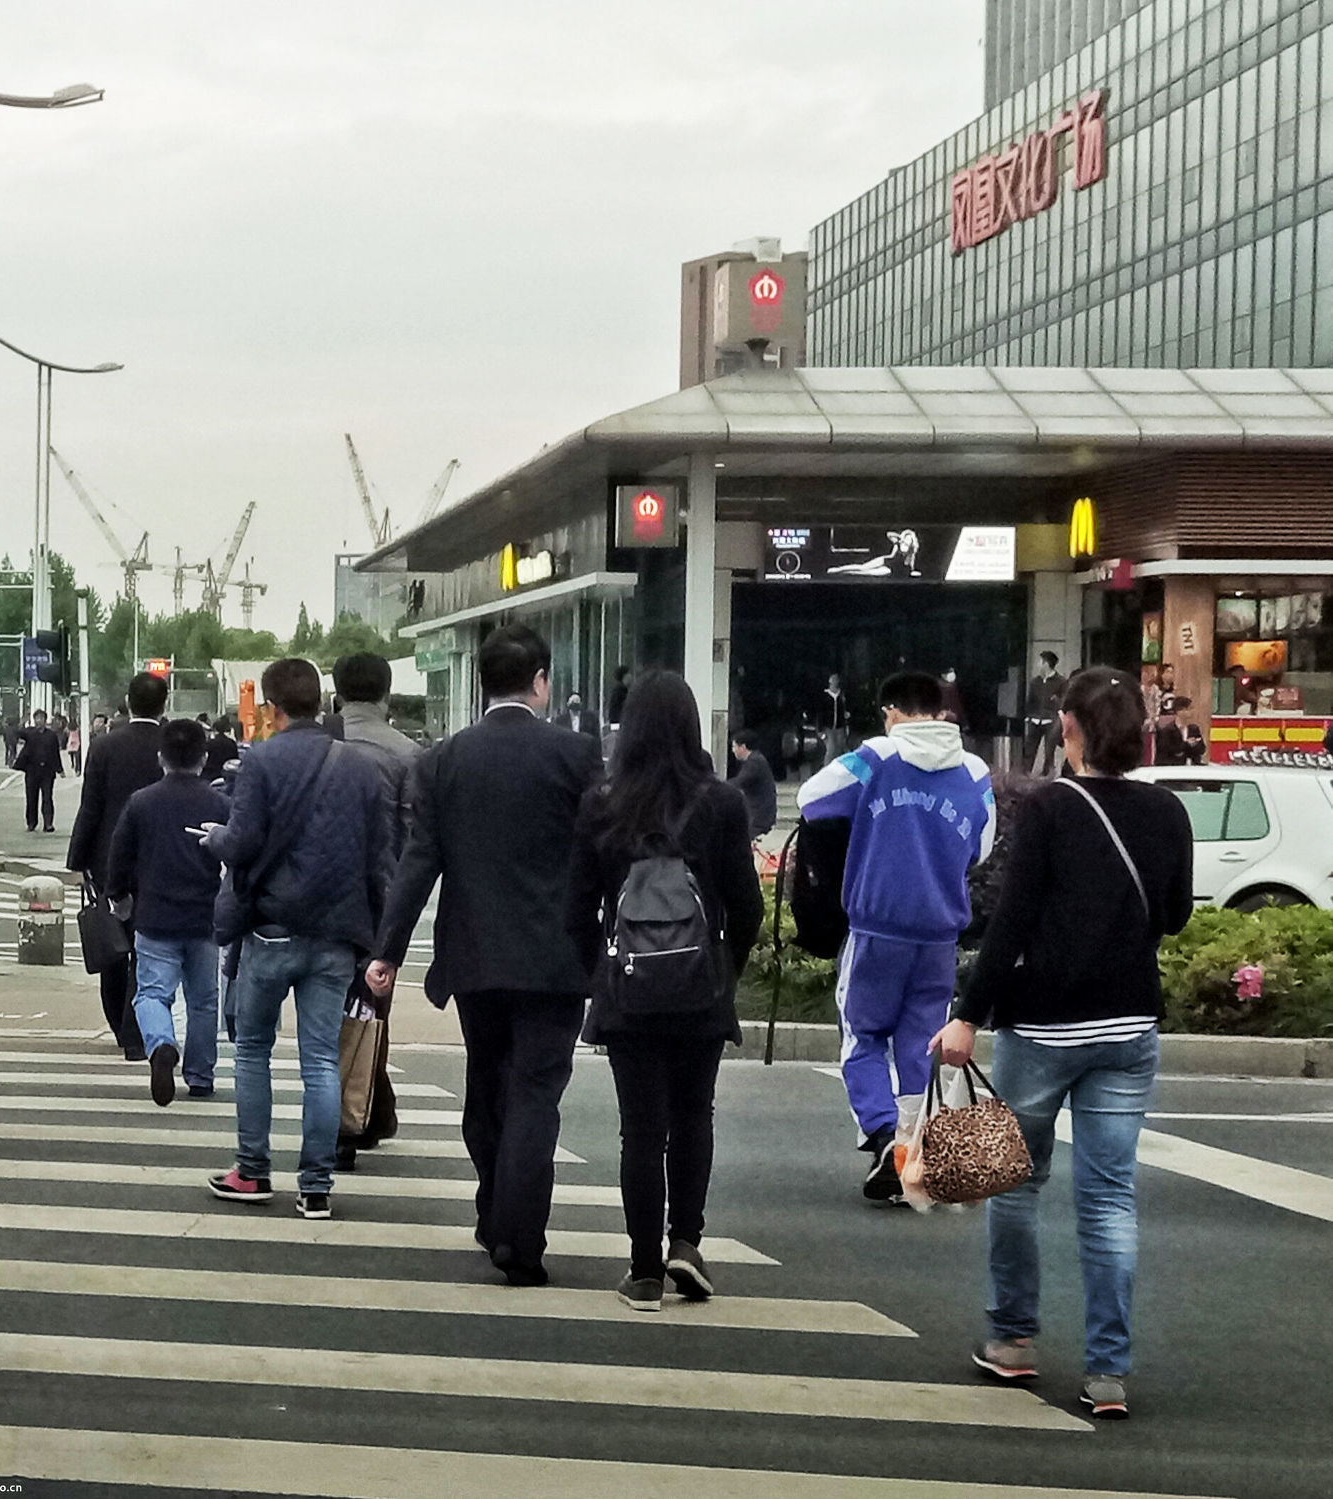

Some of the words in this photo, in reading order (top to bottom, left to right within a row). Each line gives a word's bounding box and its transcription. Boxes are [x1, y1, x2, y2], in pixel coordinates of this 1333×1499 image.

[951, 87, 1107, 255] 凤凰文化广场
